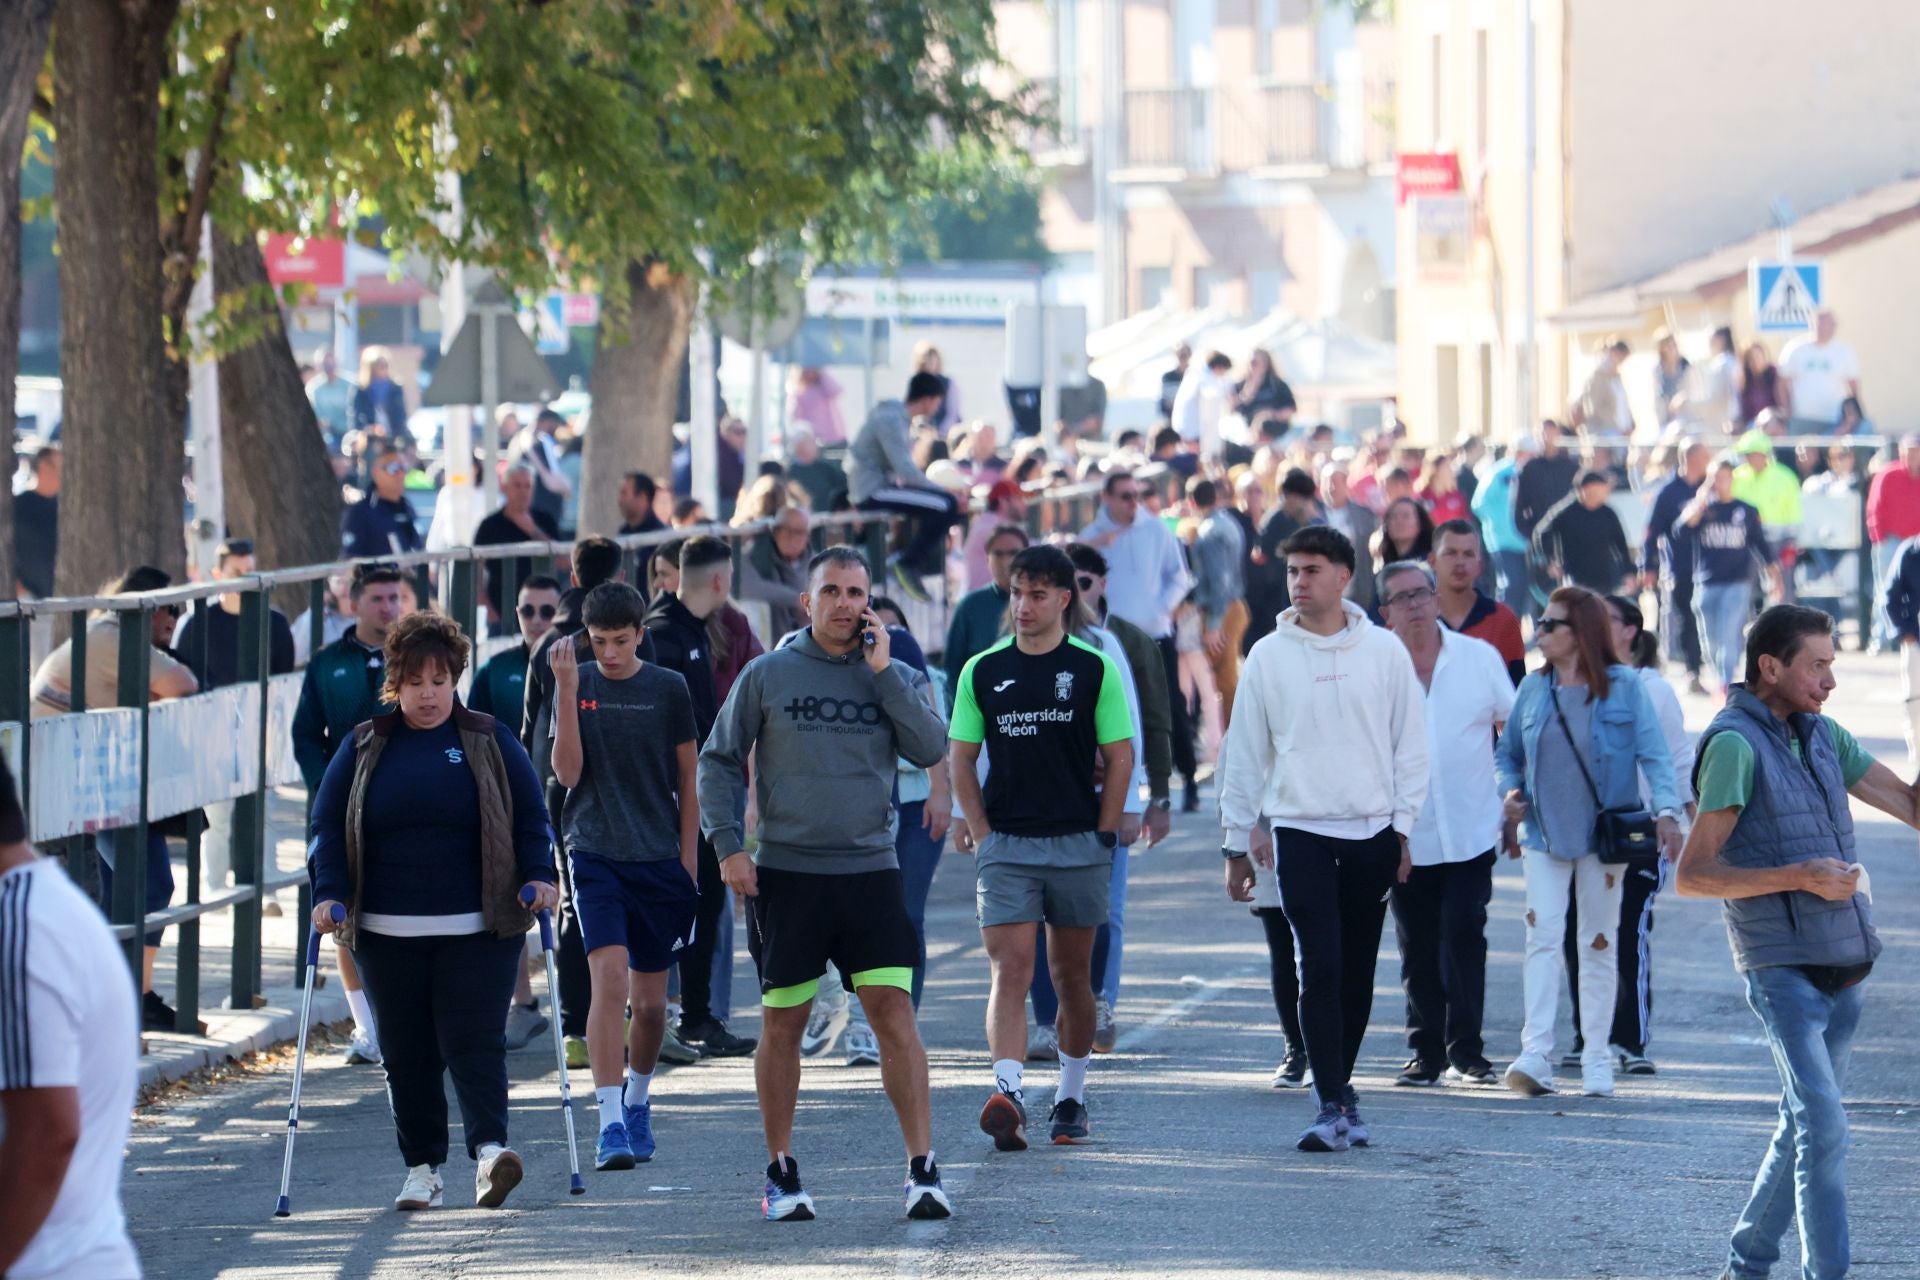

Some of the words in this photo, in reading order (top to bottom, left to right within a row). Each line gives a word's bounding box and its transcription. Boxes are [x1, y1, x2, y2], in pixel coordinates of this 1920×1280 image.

[997, 708, 1074, 725] universidad
[797, 723, 822, 732] EIGHT
[825, 725, 874, 736] THOUSAND
[1007, 722, 1037, 737] león
